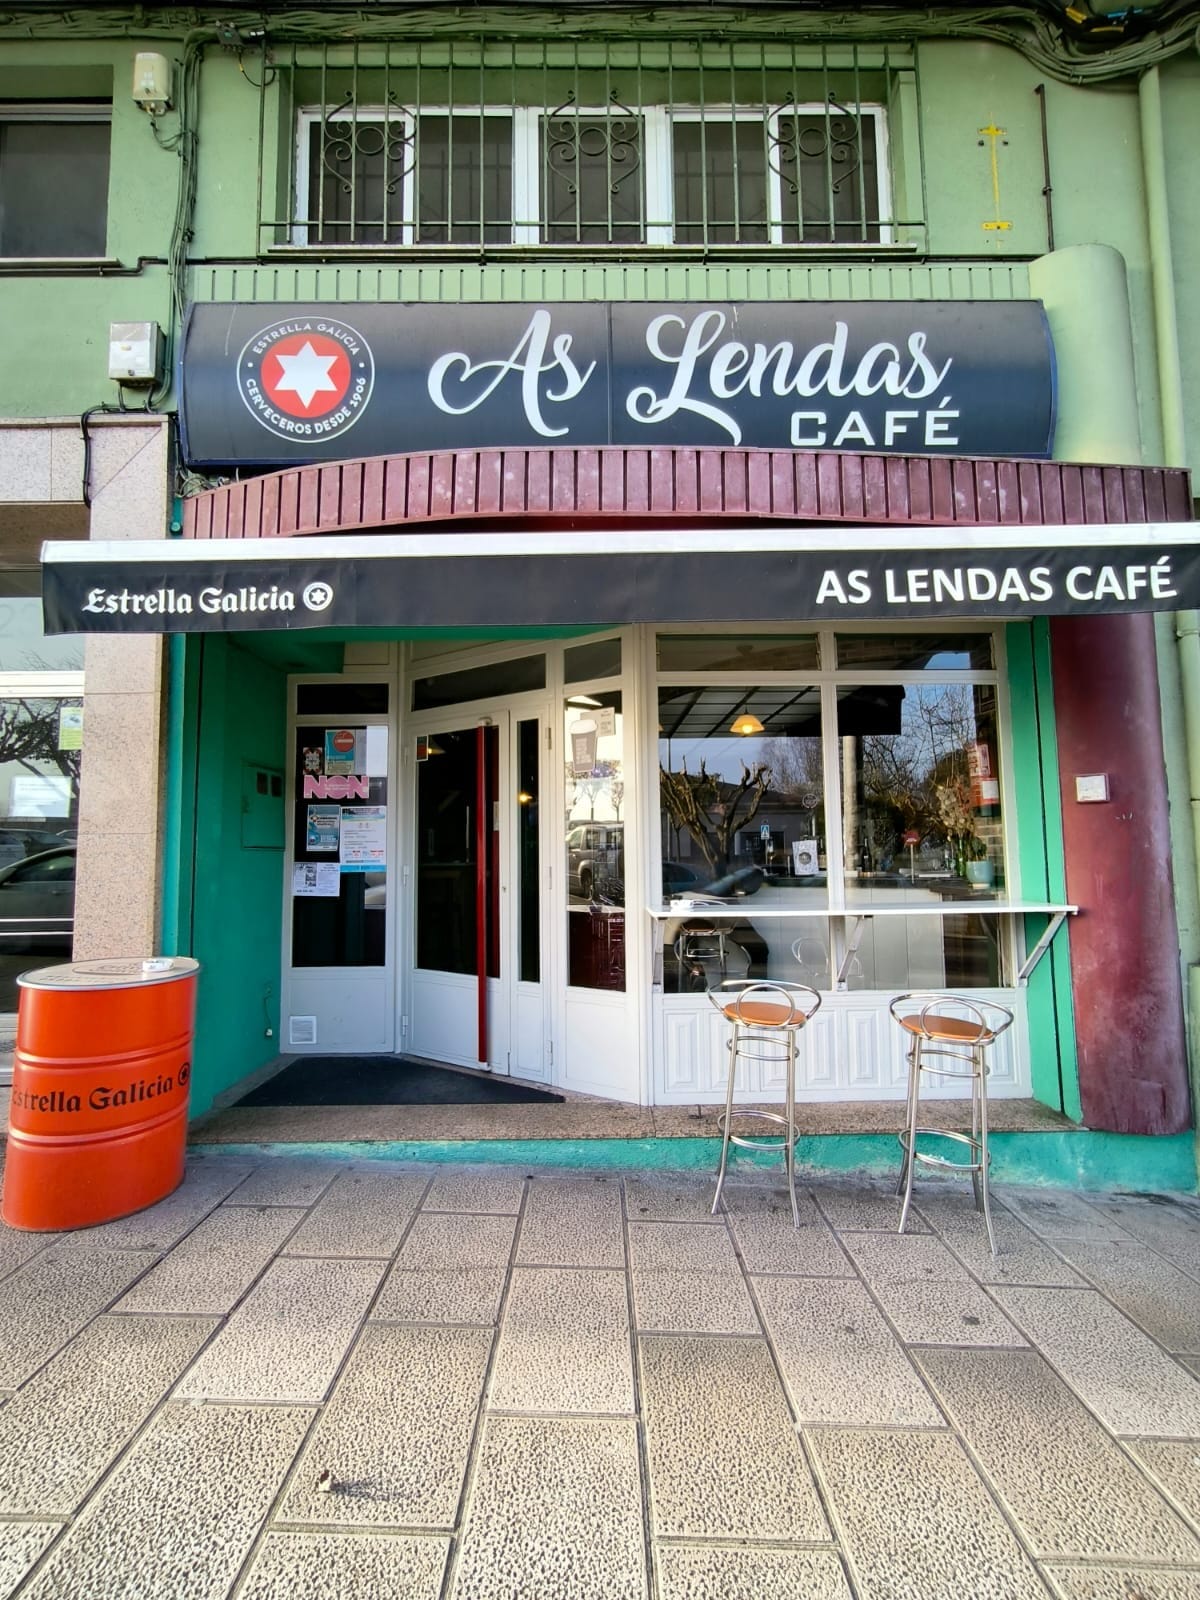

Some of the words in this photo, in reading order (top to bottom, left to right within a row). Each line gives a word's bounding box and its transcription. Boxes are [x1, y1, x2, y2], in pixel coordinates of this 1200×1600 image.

[252, 323, 312, 354] ESTRELLA
[317, 323, 360, 356] GALICIA
[428, 309, 596, 437] As
[626, 310, 952, 446] Lendas
[246, 378, 312, 434] CERVECEROS
[314, 406, 351, 434] DESDE
[350, 377, 366, 408] 1906
[790, 396, 960, 446] CAFÉ
[82, 587, 193, 614] Estrella
[199, 586, 295, 614] Galicia
[815, 570, 871, 604] AS
[885, 567, 1053, 603] LENDAS
[1065, 556, 1177, 600] CAFÉ
[304, 775, 369, 799] NON
[89, 1074, 173, 1110] Galicia
